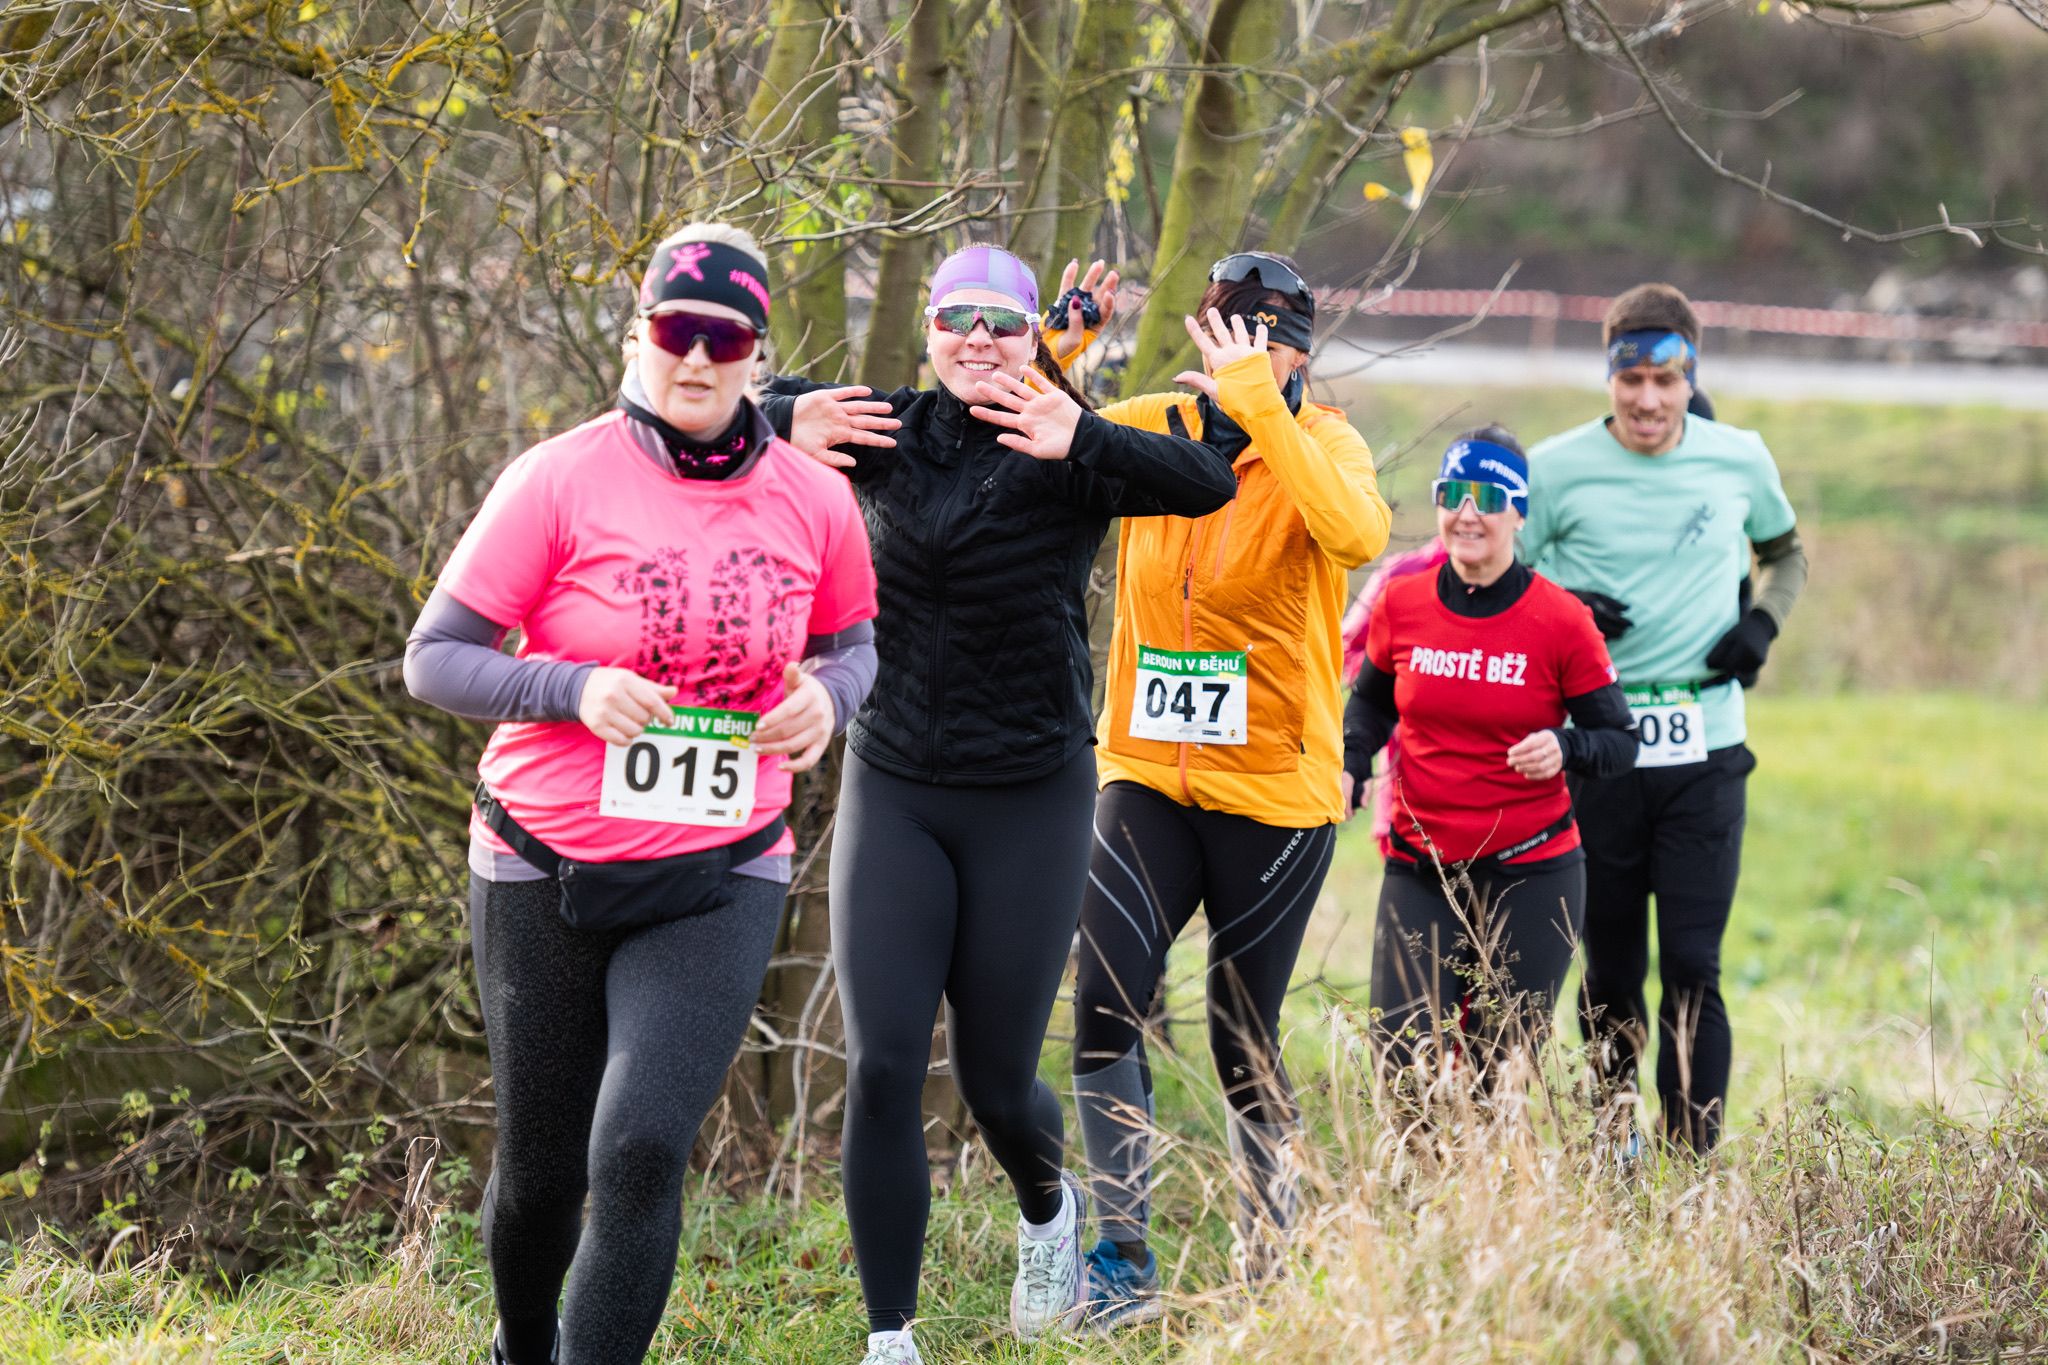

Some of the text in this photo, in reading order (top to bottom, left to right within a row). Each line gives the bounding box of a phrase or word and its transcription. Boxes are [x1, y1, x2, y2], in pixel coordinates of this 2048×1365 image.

[1142, 652, 1239, 671] BEROUN V BĚHU
[1408, 646, 1527, 686] PROSTĚ BĚŽ
[1145, 677, 1230, 723] 047
[698, 717, 712, 733] V
[713, 714, 753, 736] BĚHU
[624, 741, 739, 801] 015
[1260, 829, 1304, 883] KLIMATEX
